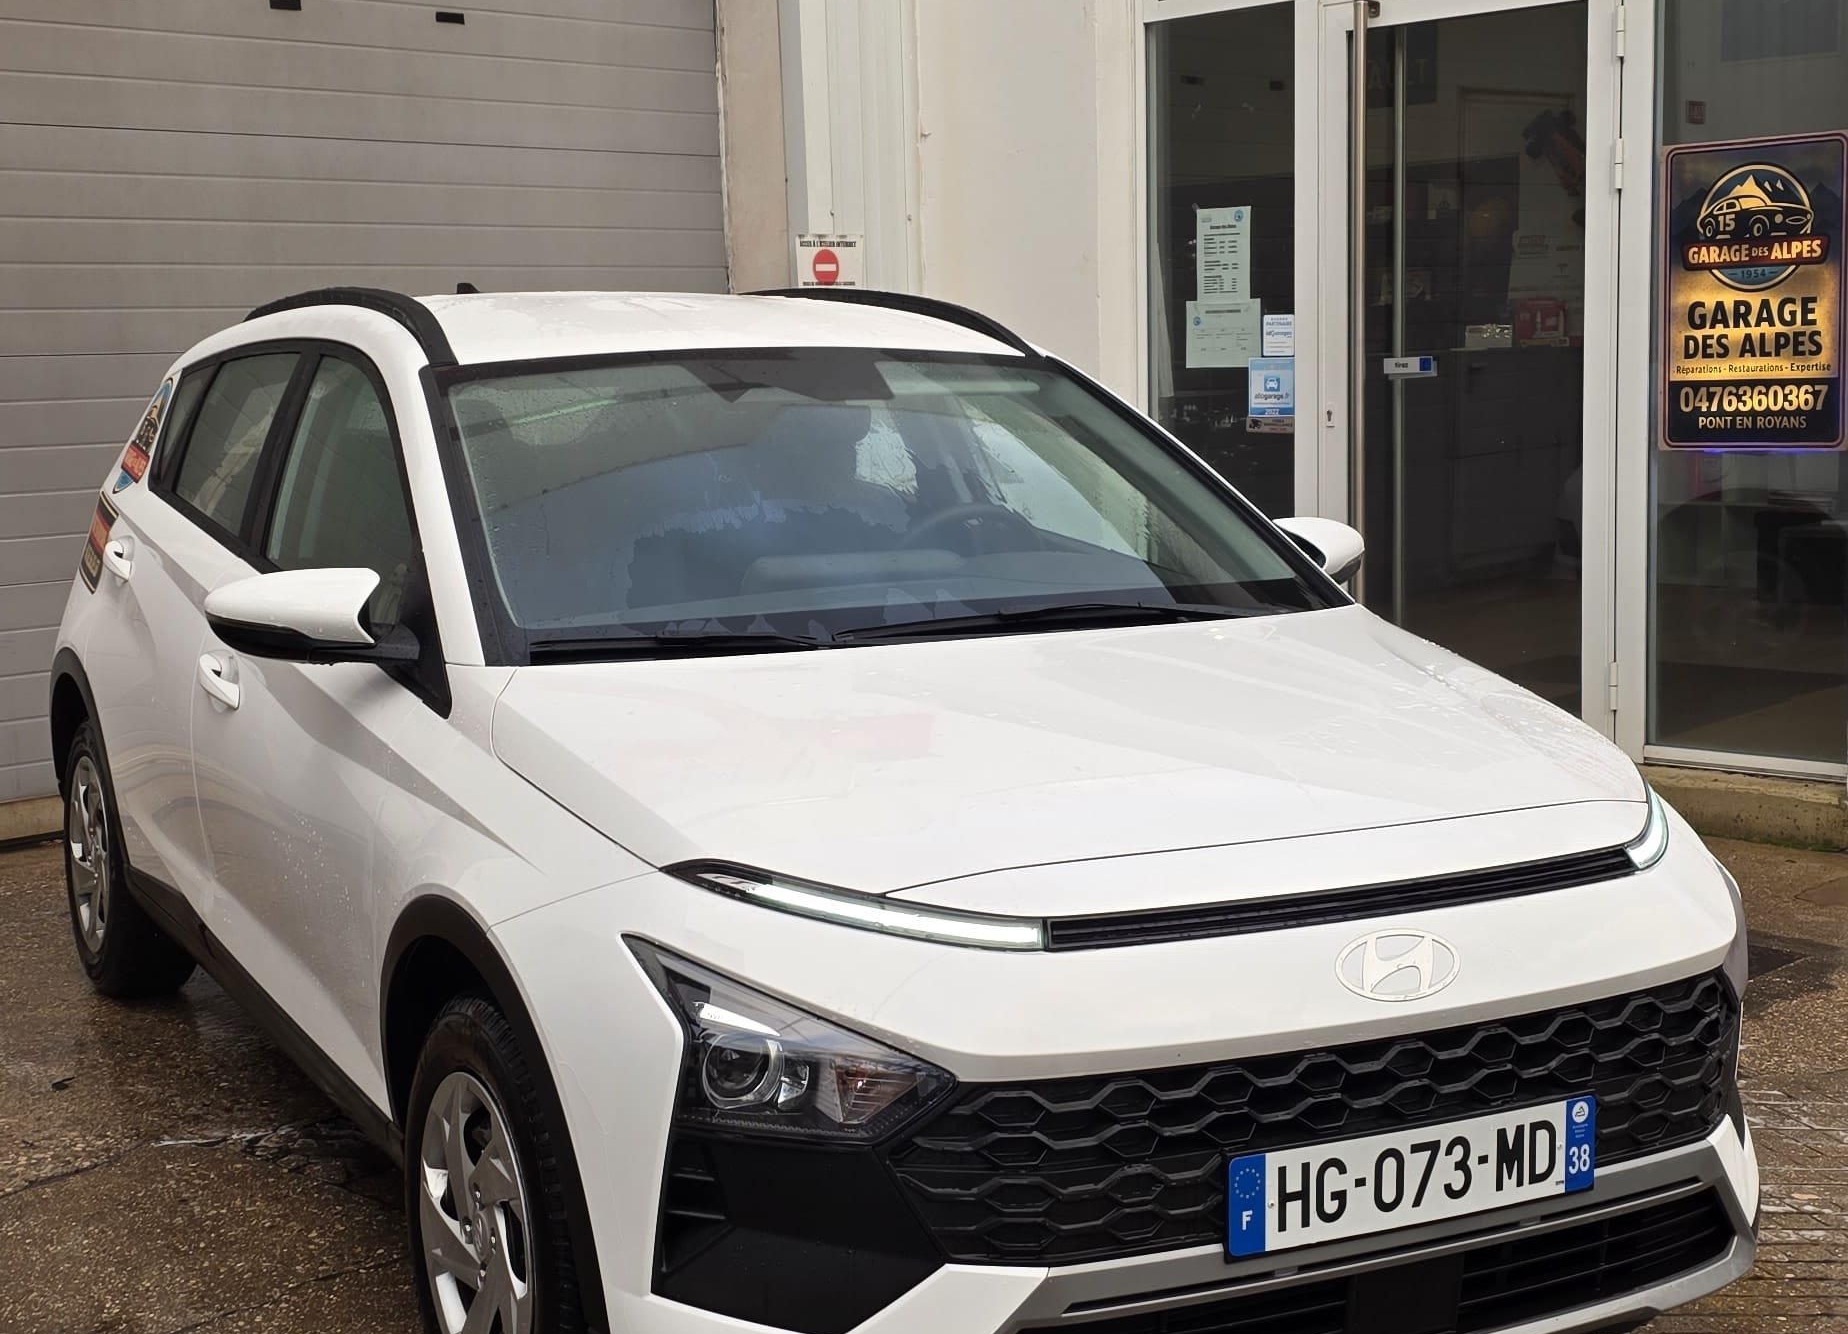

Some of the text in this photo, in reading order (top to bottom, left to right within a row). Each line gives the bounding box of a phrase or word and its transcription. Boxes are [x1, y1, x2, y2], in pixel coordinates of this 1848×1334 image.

[1718, 214, 1736, 231] 15
[1688, 239, 1822, 264] GARAGE DES ALPES
[1741, 269, 1767, 280] 1954
[1687, 296, 1818, 331] GARAGE
[1683, 330, 1823, 359] DES ALPES
[1728, 363, 1784, 373] Restaurations
[1790, 362, 1832, 373] Expertise
[1679, 384, 1829, 413] 0476360367
[1698, 415, 1807, 429] PONT EN ROYANS
[1568, 1143, 1591, 1175] 38
[1277, 1119, 1557, 1233] HG-073-MD
[1241, 1210, 1253, 1231] F
